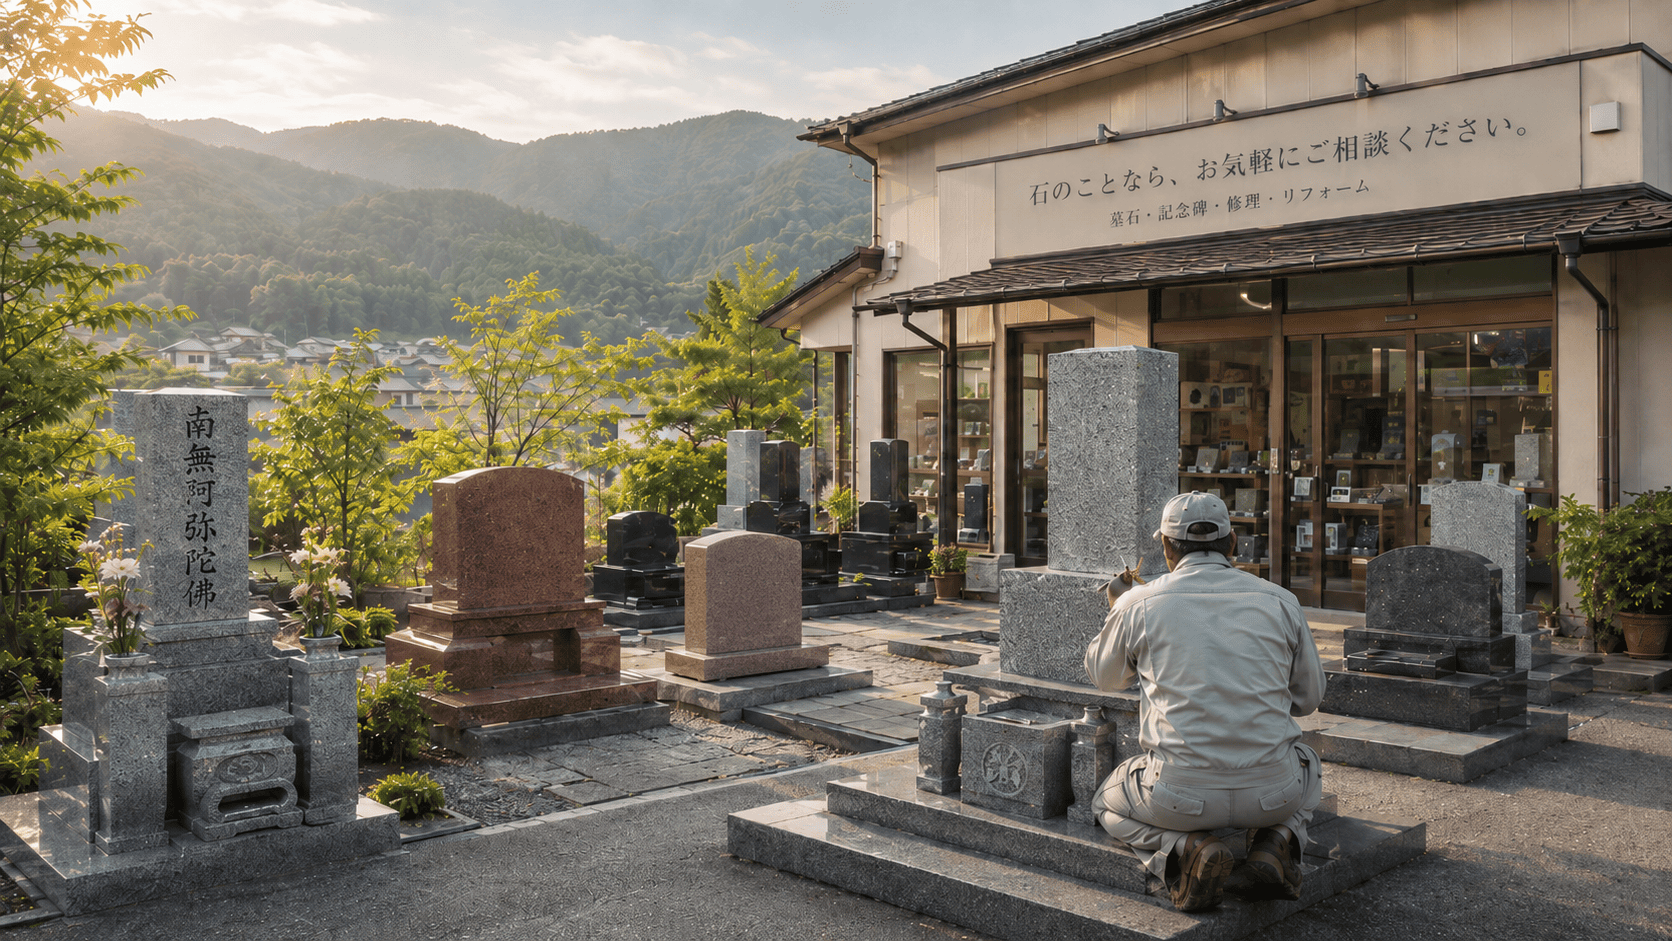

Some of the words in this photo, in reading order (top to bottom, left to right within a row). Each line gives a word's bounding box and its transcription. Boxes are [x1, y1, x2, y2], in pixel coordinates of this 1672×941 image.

[1028, 117, 1528, 206] 石のことなら、お気軽にご相談ください。
[183, 405, 217, 610] 南無阿弥陀佛
